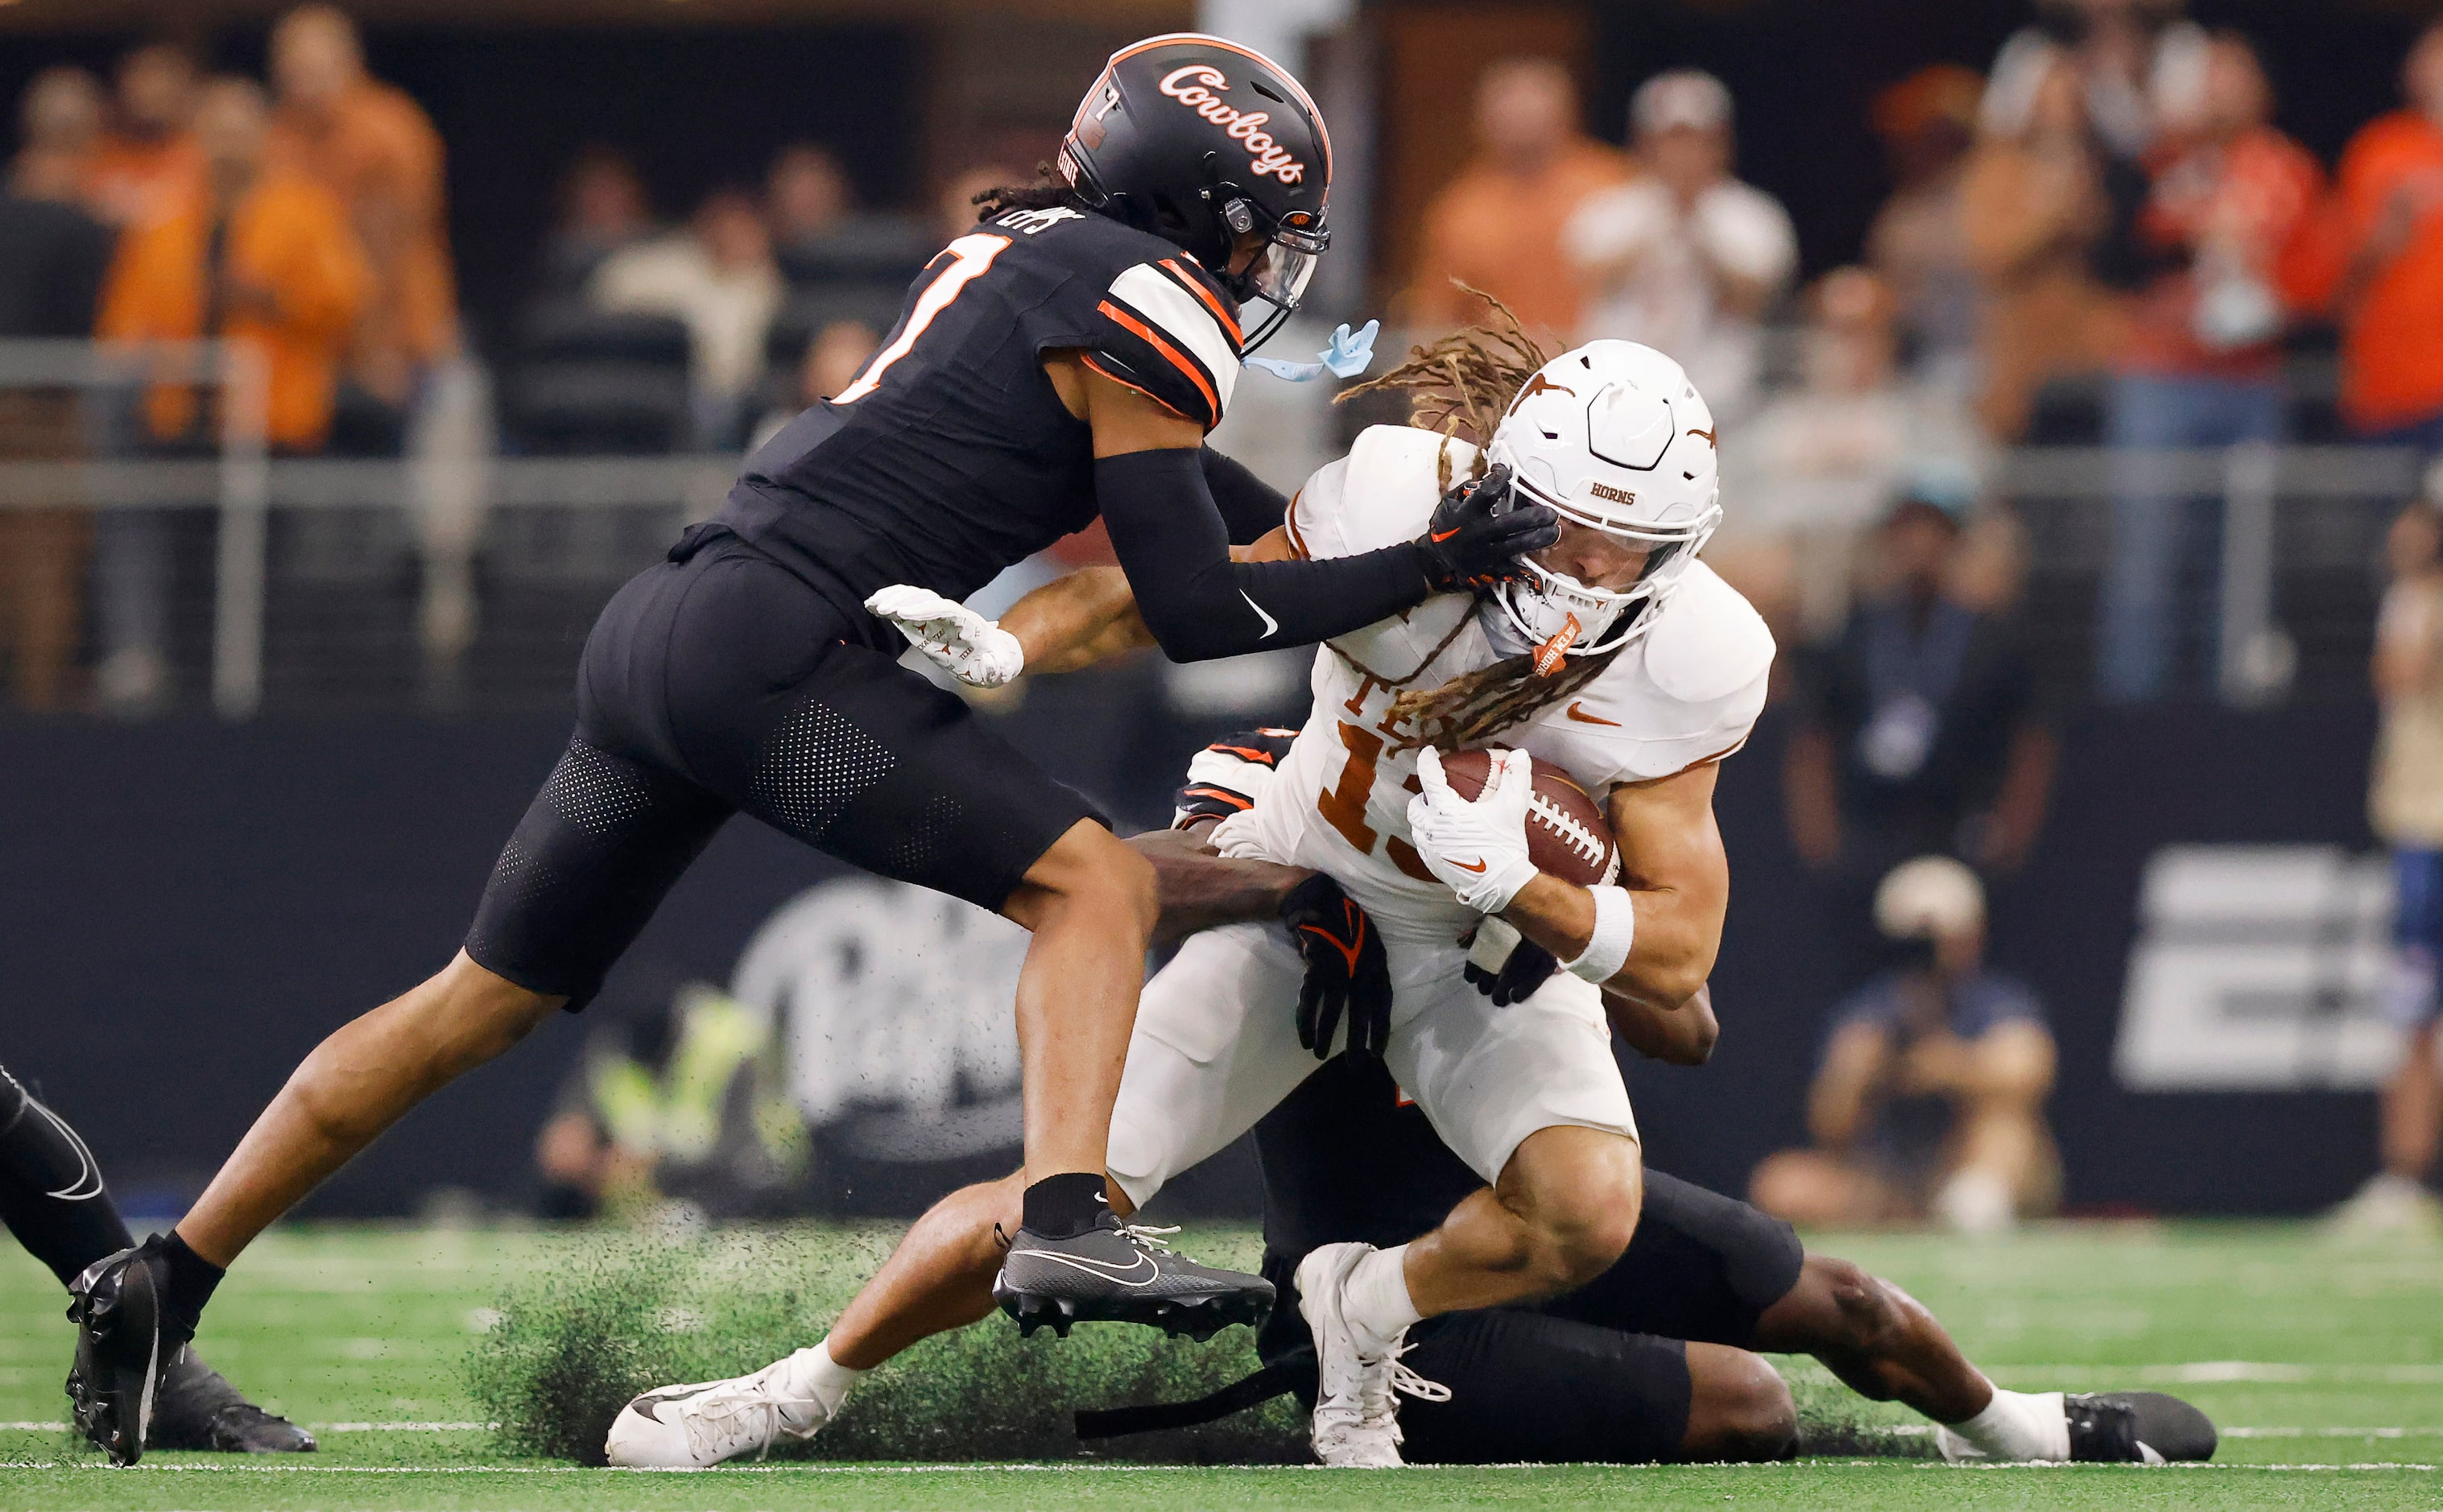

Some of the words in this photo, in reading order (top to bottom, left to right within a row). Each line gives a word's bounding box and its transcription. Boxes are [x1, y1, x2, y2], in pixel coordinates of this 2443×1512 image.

[1095, 86, 1121, 122] 7
[1158, 64, 1305, 185] Cowboys
[829, 231, 1014, 405] 7
[1590, 482, 1635, 506] HORNS
